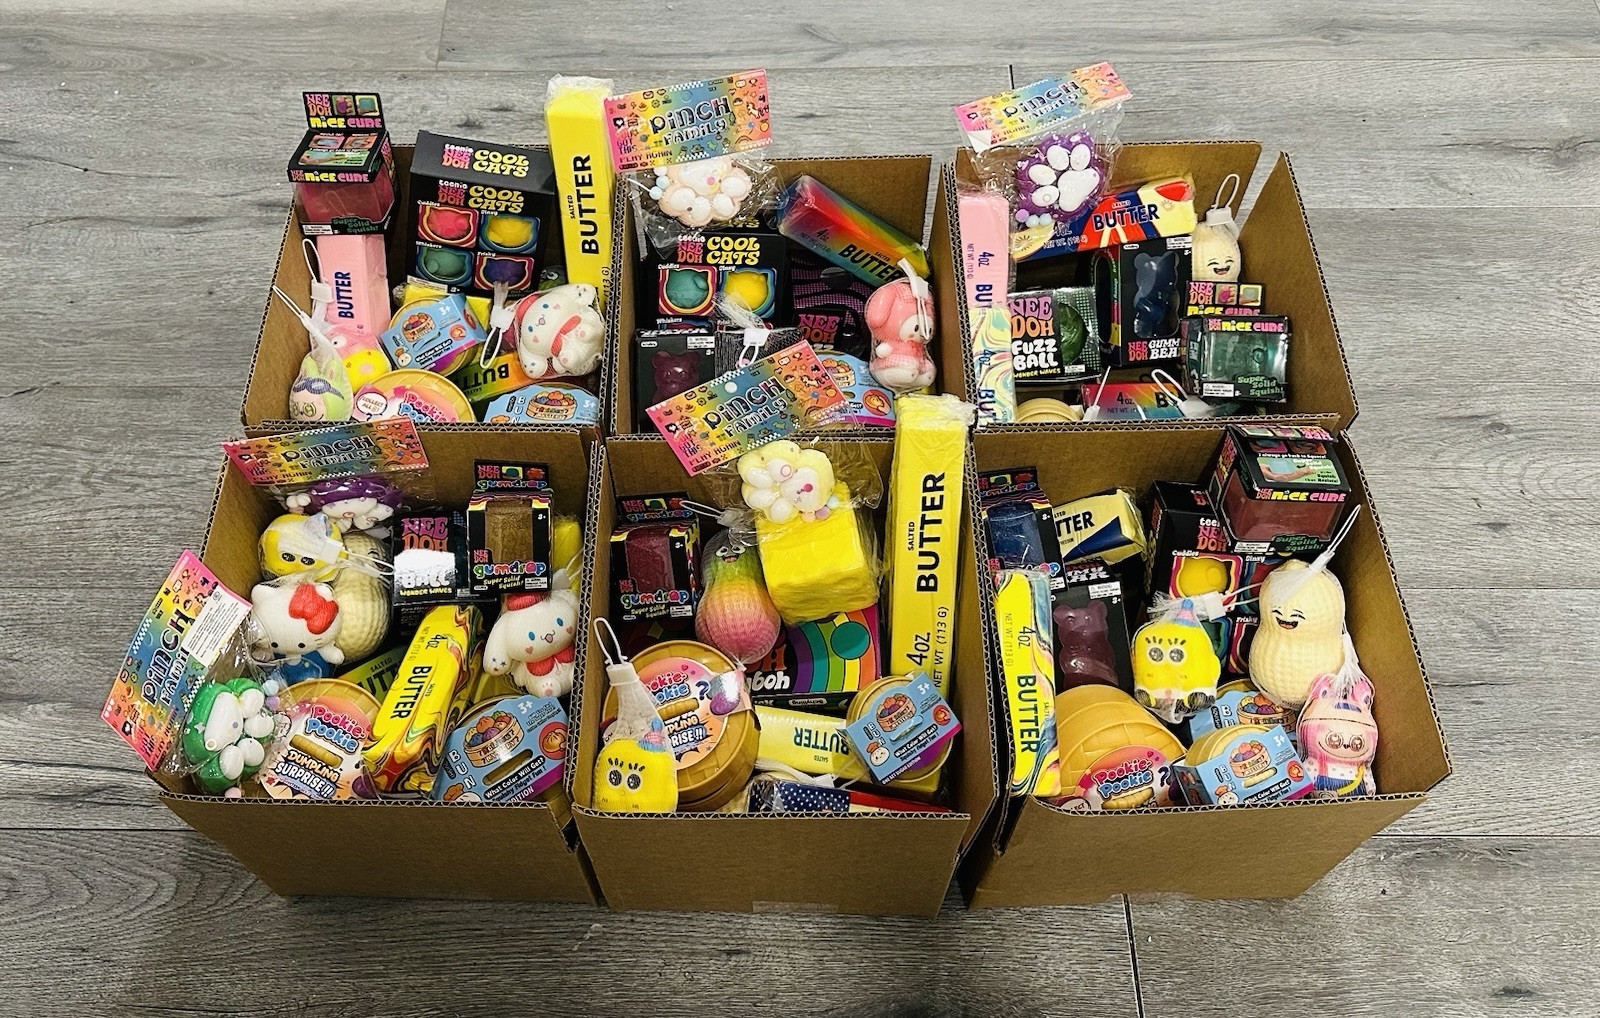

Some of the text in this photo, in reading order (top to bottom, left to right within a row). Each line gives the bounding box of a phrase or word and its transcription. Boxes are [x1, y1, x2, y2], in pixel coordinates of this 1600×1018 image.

[305, 93, 330, 106] NEE
[308, 104, 332, 116] DOH
[474, 149, 530, 166] COOL
[442, 156, 529, 178] DOH CATS
[469, 186, 524, 202] COOL
[438, 192, 524, 214] DOH CATS
[566, 195, 576, 220] SALTED
[573, 154, 600, 254] BUTTER
[1092, 203, 1160, 232] BUTTER
[677, 236, 760, 254] NEE COOL
[677, 250, 760, 265] DOH CATS
[334, 272, 354, 318] BUTTER
[1189, 282, 1214, 295] NEE
[1188, 292, 1213, 304] DOH
[439, 305, 451, 316] 3+
[1008, 296, 1053, 320] NEE
[798, 314, 840, 332] NEE
[1011, 314, 1055, 338] DOH
[1012, 338, 1058, 356] FUZZ
[1128, 342, 1148, 352] NEE
[1014, 352, 1058, 372] BALL
[1128, 350, 1148, 361] DOH
[1014, 370, 1038, 378] WONDER
[1237, 376, 1266, 384] Super
[1252, 380, 1276, 388] Solid
[583, 400, 597, 408] 3+
[476, 479, 548, 490] gumdrop
[626, 510, 694, 521] gumdrop
[401, 518, 449, 539] NEE
[916, 472, 946, 592] BUTTER
[1056, 510, 1096, 538] TTER
[402, 532, 449, 552] DOH
[1196, 536, 1227, 552] DOH
[1276, 535, 1306, 543] Super
[1290, 538, 1318, 546] Solid
[1285, 544, 1324, 552] Squish!
[473, 561, 546, 580] gumdrop
[483, 578, 503, 586] Super
[503, 576, 521, 584] Solid
[400, 586, 452, 596] WONDER WAVES
[621, 590, 690, 609] gumdrop
[631, 606, 649, 615] Super
[938, 606, 950, 618] G)
[936, 622, 948, 644] (113
[1005, 628, 1013, 638] WT
[1004, 641, 1014, 657] (113
[370, 658, 393, 672] SALTED
[1005, 658, 1014, 668] G)
[934, 668, 942, 688] NET
[390, 666, 432, 720] BUTTER
[656, 682, 690, 703] okie
[917, 682, 930, 695] 3+
[518, 700, 533, 714] 3+
[1016, 675, 1040, 754] BUTTER
[667, 714, 699, 732] PLING
[306, 718, 359, 752] Pookie
[894, 724, 938, 758] What Color Will Get?
[1273, 735, 1285, 746] 3+
[287, 750, 340, 781] DUMPLING
[814, 754, 829, 763] SALTED
[485, 757, 545, 798] What Color Will Get?
[515, 769, 543, 790] Fidget Fun
[1098, 770, 1152, 798] Pookie
[1258, 790, 1270, 800] Color
[1270, 785, 1280, 794] Will
